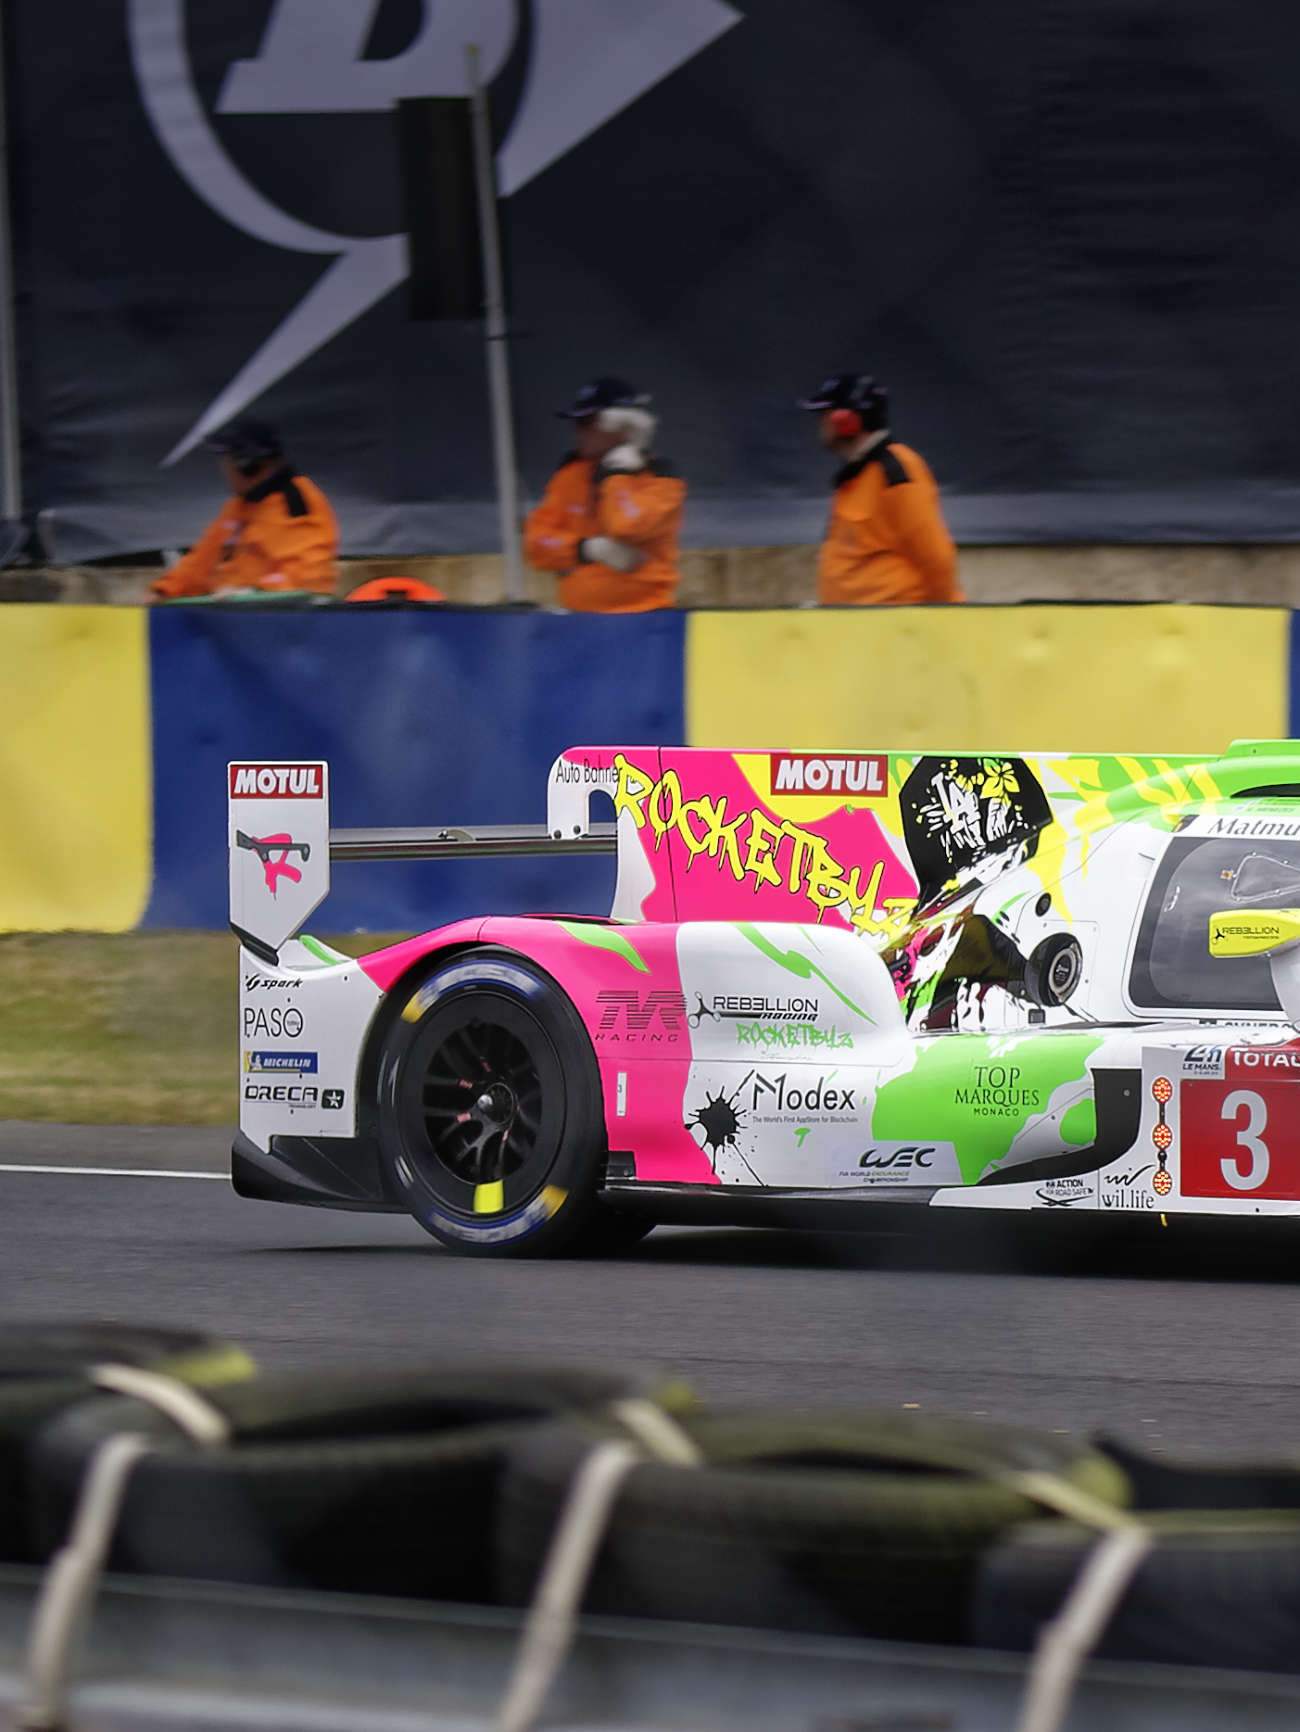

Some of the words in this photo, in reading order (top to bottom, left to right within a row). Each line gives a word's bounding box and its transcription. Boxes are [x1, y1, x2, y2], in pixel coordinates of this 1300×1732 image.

[555, 758, 581, 784] Auto
[775, 759, 884, 791] MOTUL
[233, 768, 320, 795] MOTUL
[260, 978, 303, 990] spark
[713, 996, 818, 1012] REBELLION
[594, 1033, 679, 1043] RACING
[263, 1057, 312, 1069] MICHELIN
[1183, 1063, 1194, 1071] LE
[1194, 1063, 1220, 1071] MANS
[974, 1066, 1020, 1088] TOP
[245, 1085, 319, 1102] ORECA
[753, 1073, 856, 1110] Modex
[954, 1089, 1040, 1107] MARQUES
[974, 1107, 1020, 1117] MONACO
[1220, 1089, 1270, 1191] 3
[859, 1146, 936, 1168] WEC
